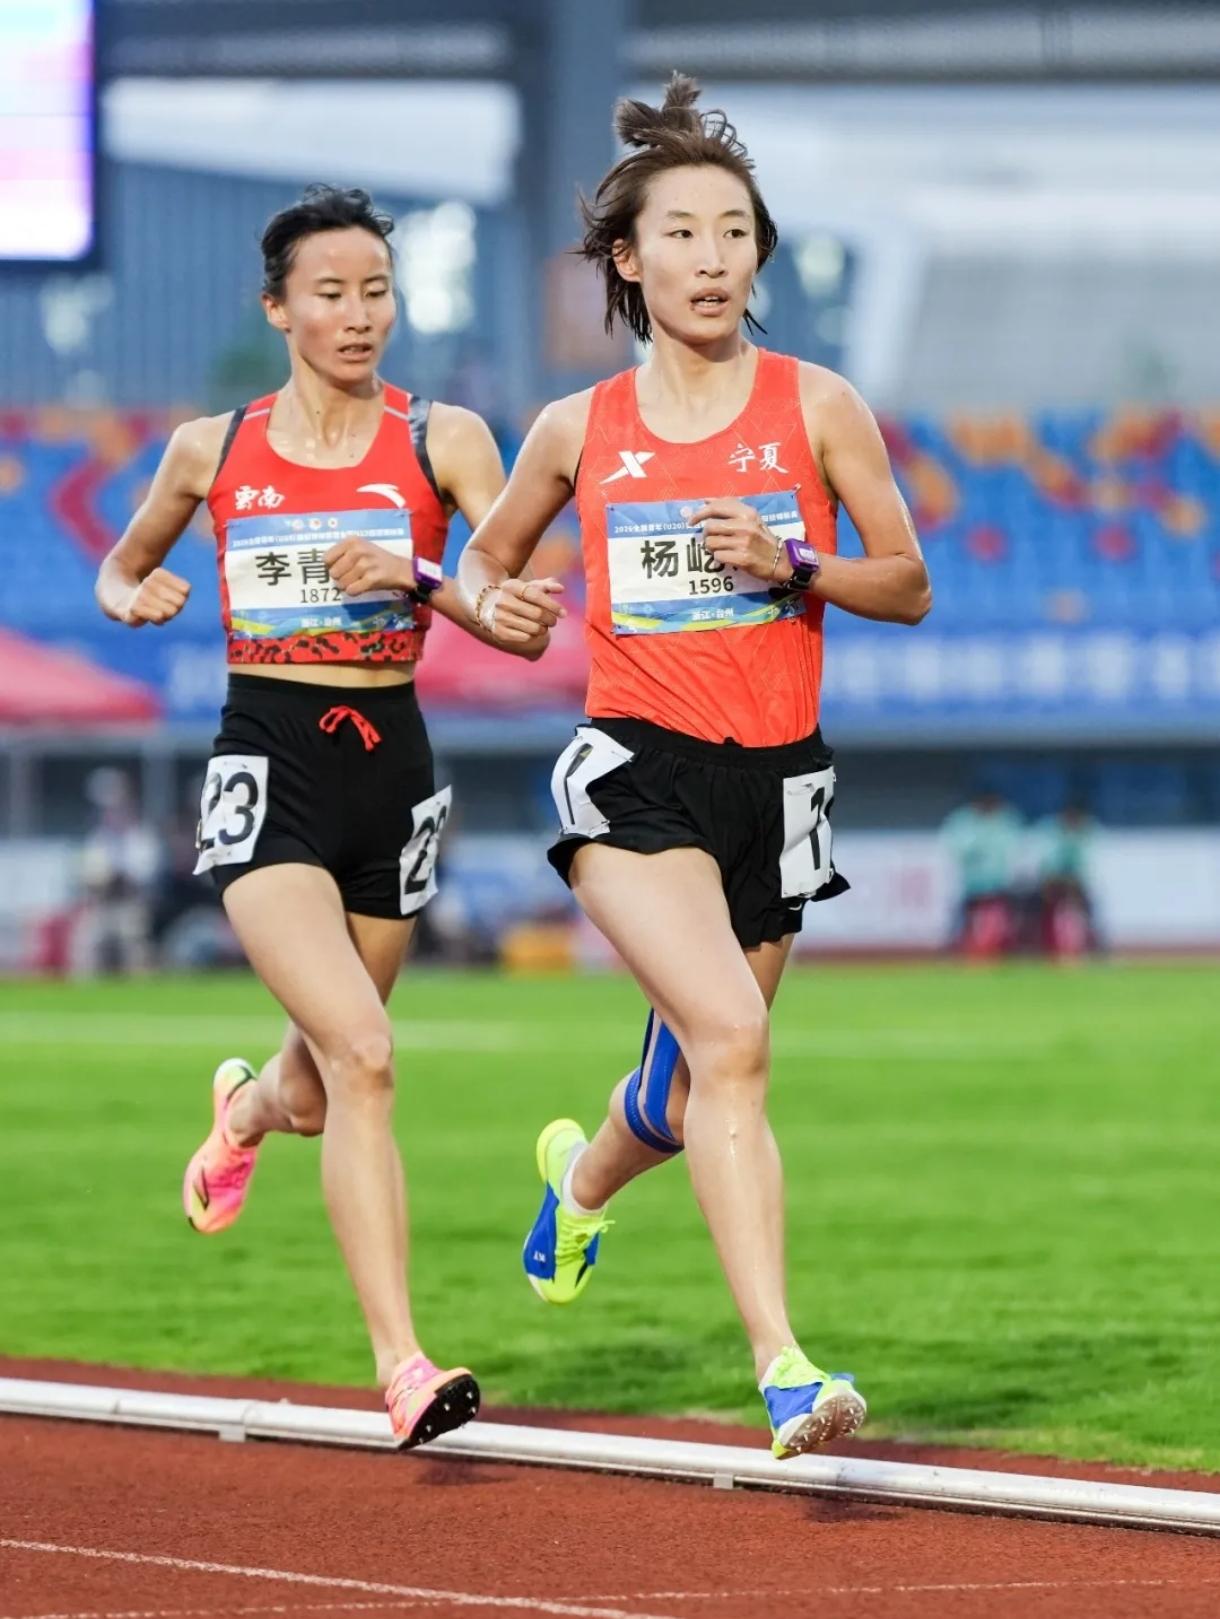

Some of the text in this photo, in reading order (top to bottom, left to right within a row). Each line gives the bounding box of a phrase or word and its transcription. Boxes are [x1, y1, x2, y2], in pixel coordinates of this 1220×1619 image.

[728, 442, 789, 474] 宁夏
[300, 587, 342, 603] 1872
[688, 576, 734, 595] 1596
[200, 771, 259, 850] 23
